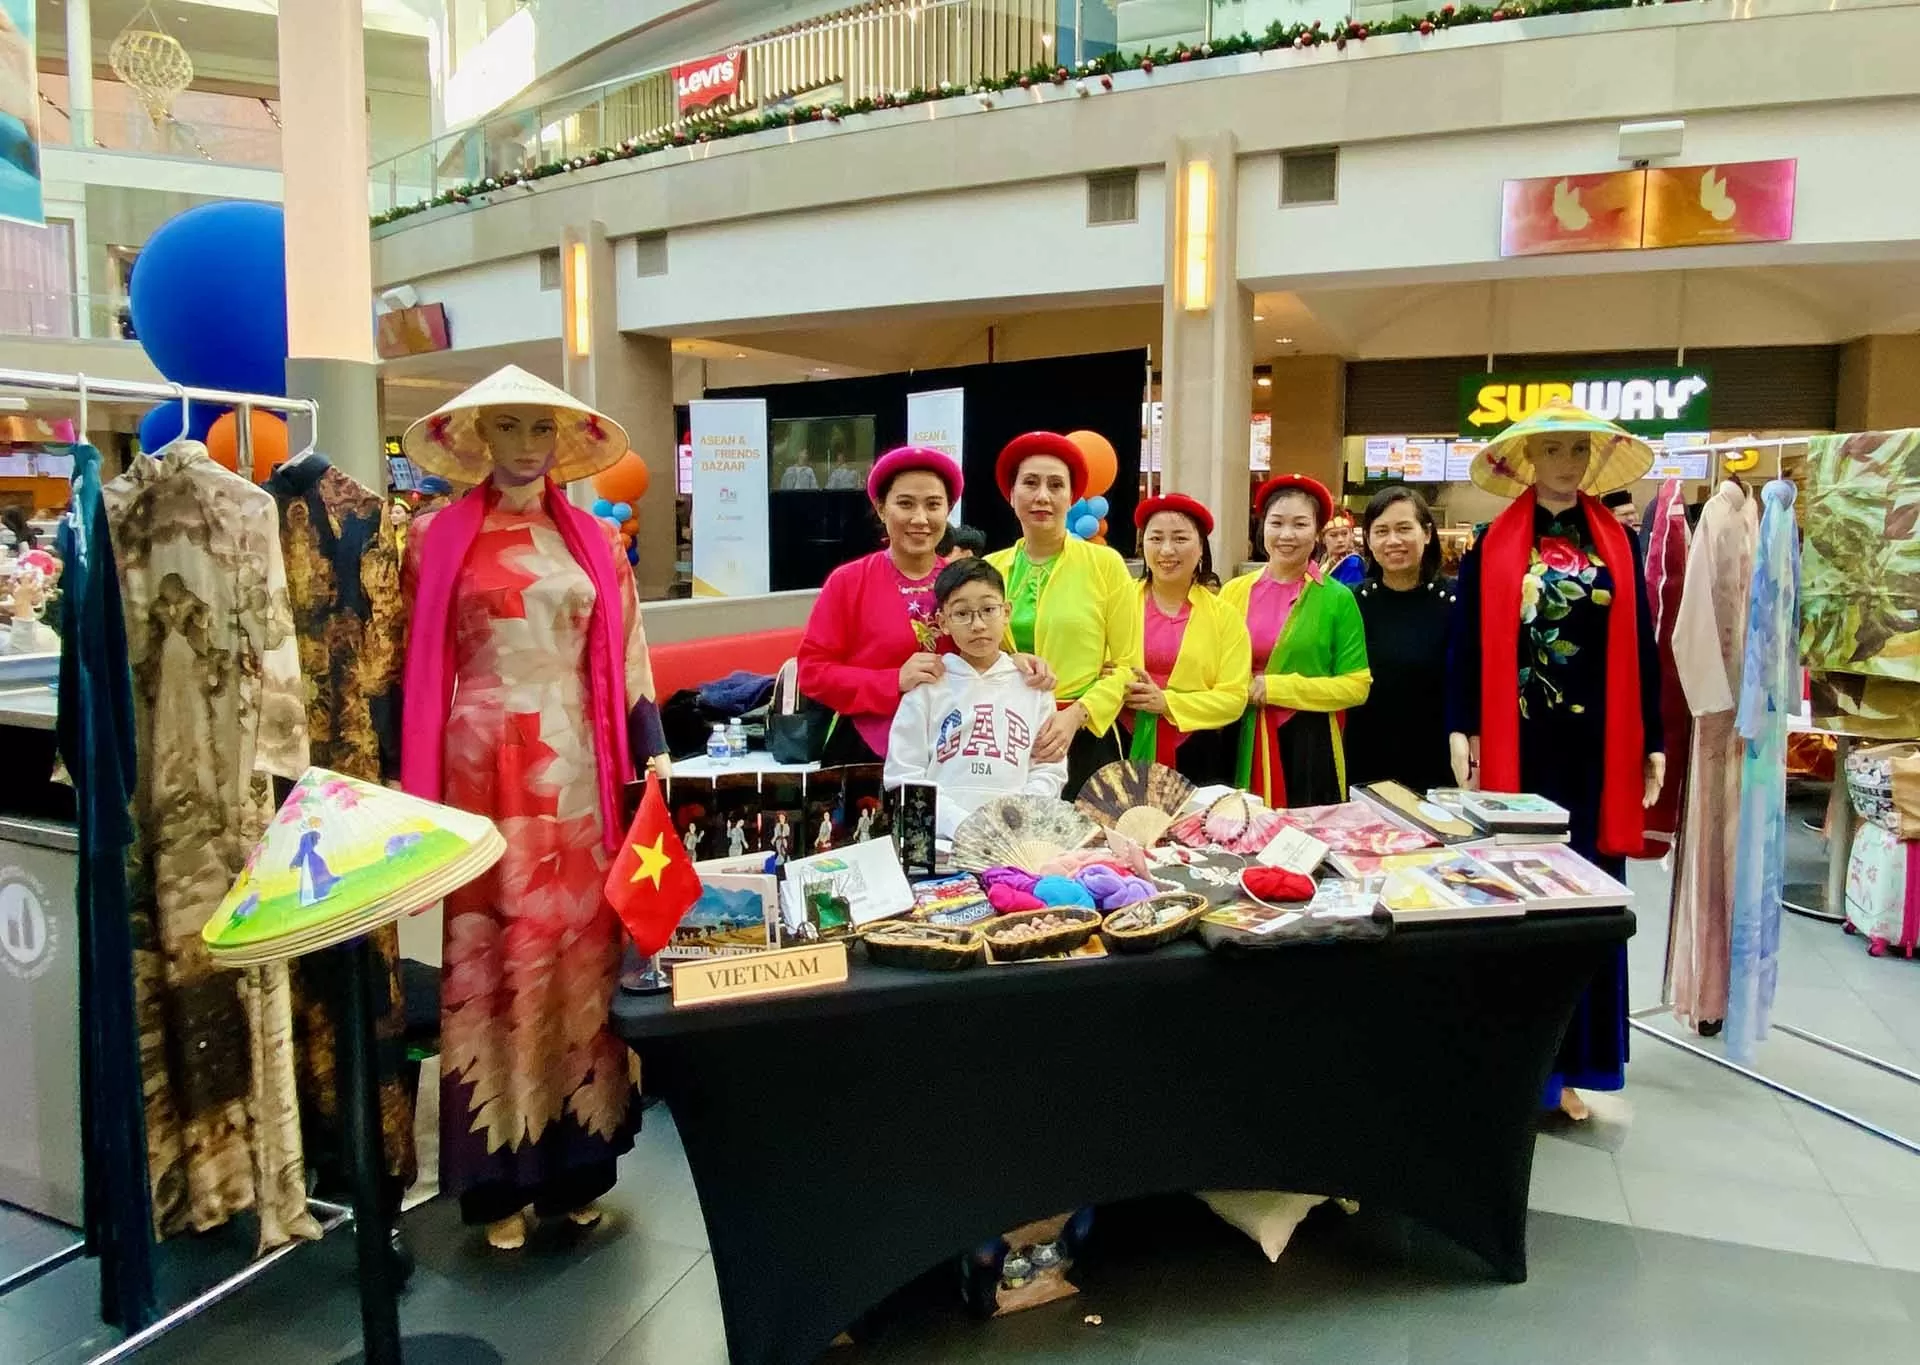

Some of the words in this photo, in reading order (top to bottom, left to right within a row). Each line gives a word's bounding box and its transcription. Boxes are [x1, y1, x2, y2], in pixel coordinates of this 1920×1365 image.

[701, 435, 736, 446] ASEAN
[714, 447, 761, 459] FRIENDS
[701, 461, 746, 472] BAZAAR
[936, 704, 1031, 768] GAP
[971, 763, 993, 776] USA
[706, 957, 819, 989] VIETNAM
